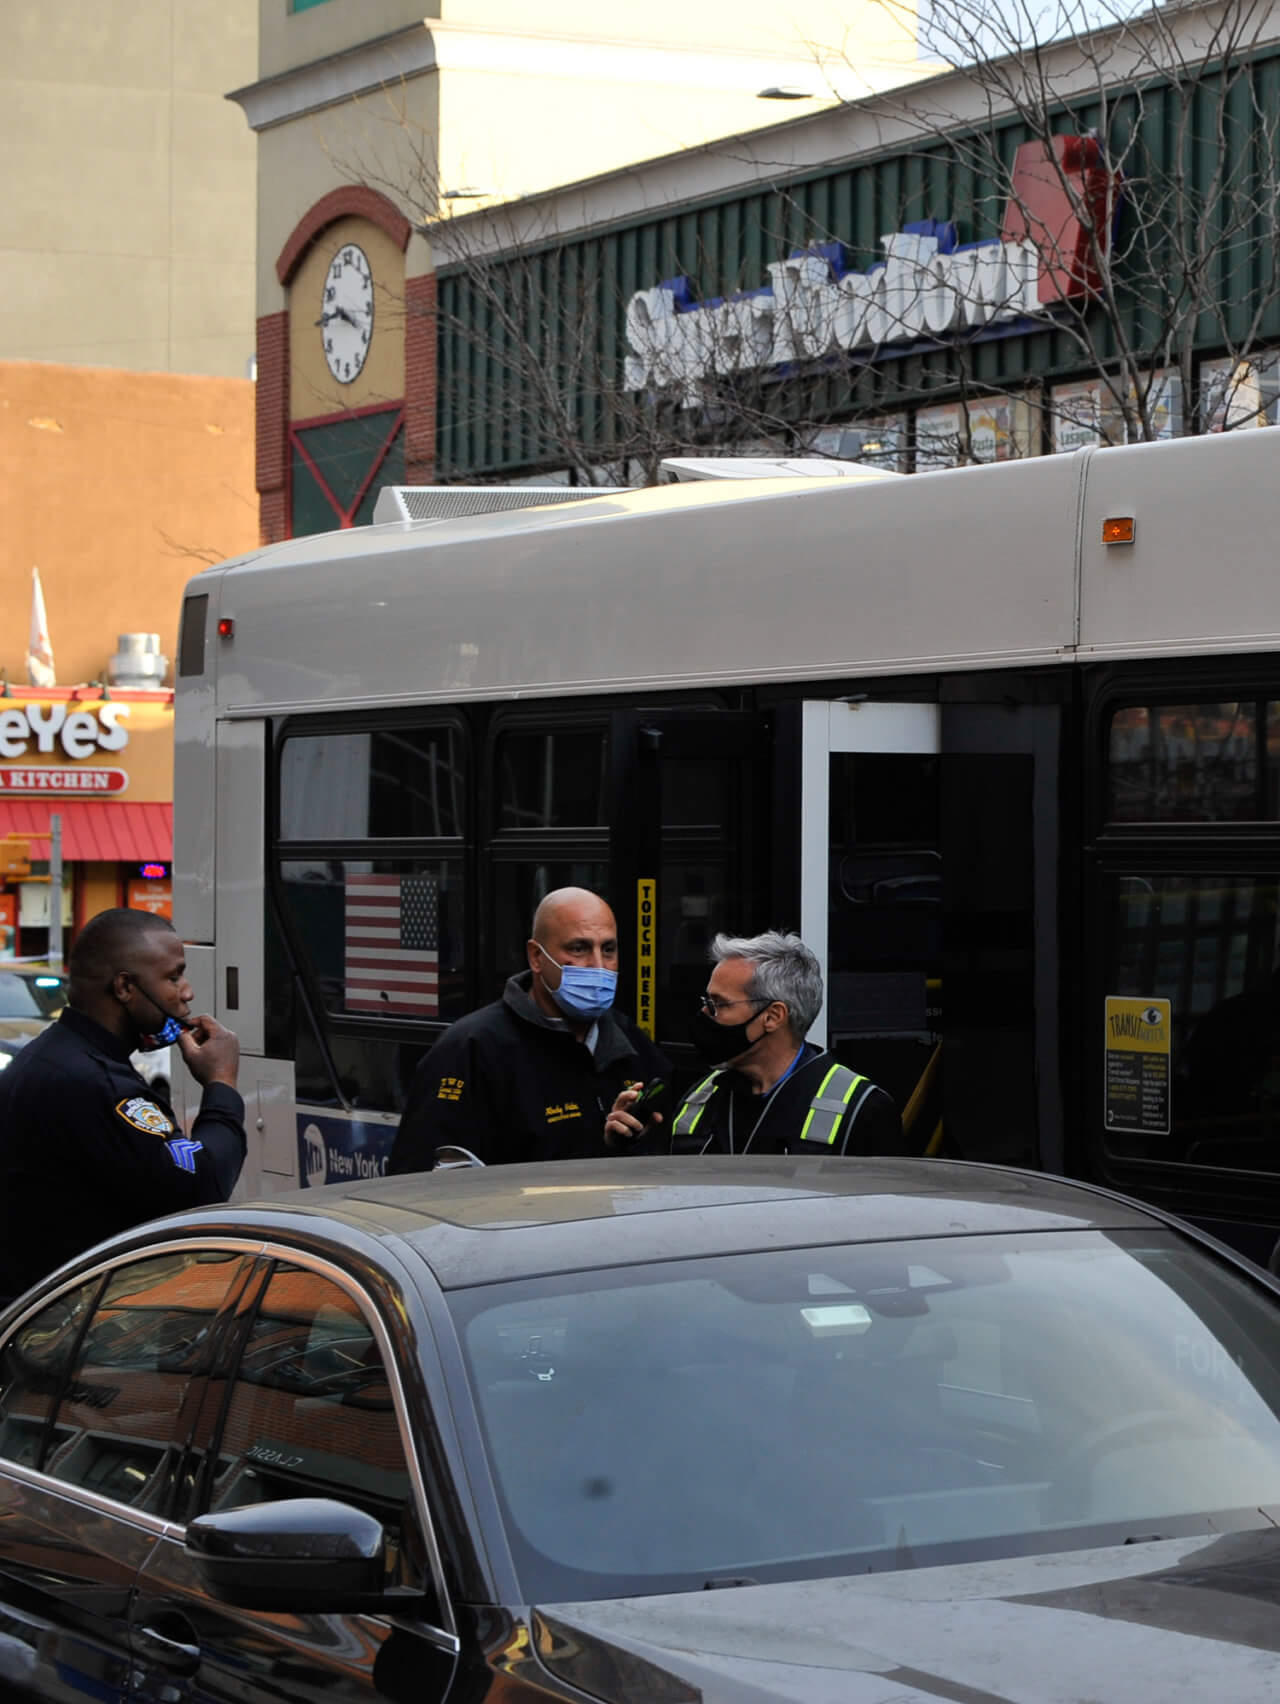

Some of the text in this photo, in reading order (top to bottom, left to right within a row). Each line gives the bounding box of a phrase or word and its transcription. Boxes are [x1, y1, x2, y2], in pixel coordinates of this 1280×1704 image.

[11, 772, 110, 788] KITCHEN
[640, 886, 651, 1022] TOUCH HERE
[329, 1148, 353, 1175] New
[354, 1152, 380, 1178] York
